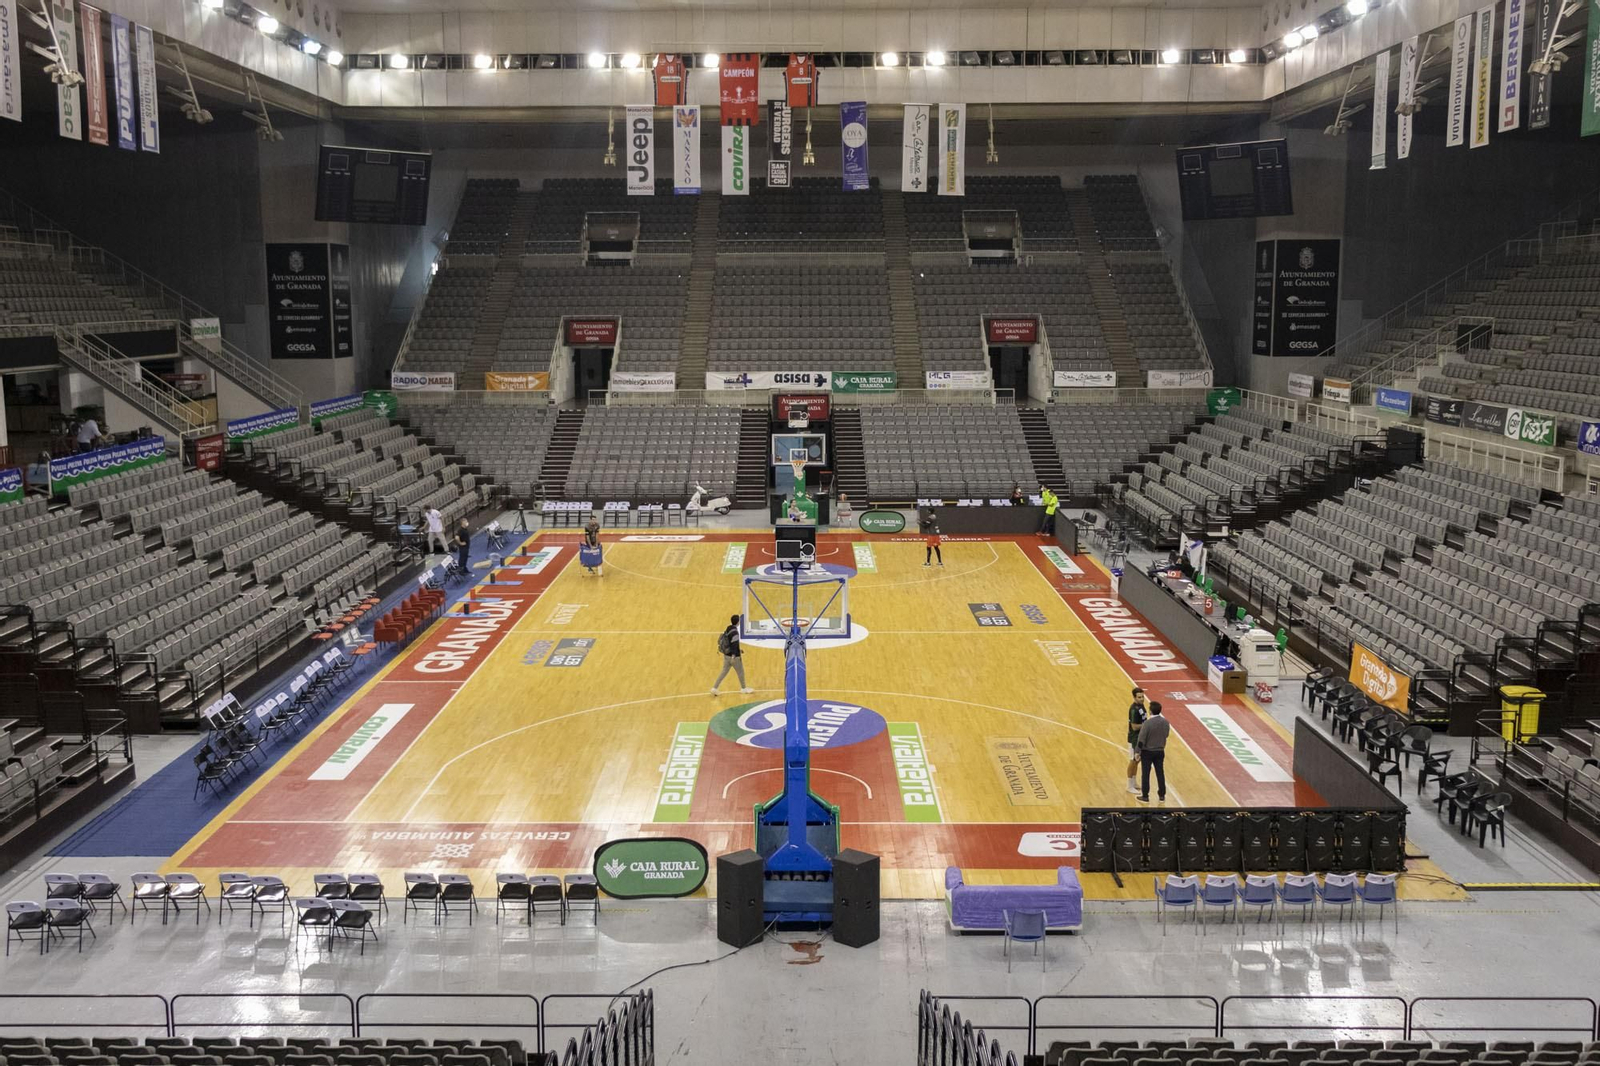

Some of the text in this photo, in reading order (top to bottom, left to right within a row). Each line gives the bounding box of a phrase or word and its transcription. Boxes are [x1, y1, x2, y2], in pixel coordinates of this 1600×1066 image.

[1506, 0, 1521, 100] BERNER
[666, 66, 674, 74] 18
[723, 67, 755, 79] CAMPEÓN
[799, 67, 804, 75] 8
[1477, 61, 1487, 142] ALHAMBRA
[773, 111, 781, 143] VERDAD
[628, 117, 653, 182] Jeep
[683, 130, 691, 184] MANZANO
[271, 273, 326, 281] AYUNTAMIENTO
[1279, 270, 1336, 278] AYUNTAMIENTO
[1295, 278, 1330, 287] GRANADA
[287, 281, 322, 290] GRANADA
[393, 377, 453, 385] RADIO MARCA
[774, 373, 810, 384] asisa
[1205, 598, 1212, 609] 5
[414, 599, 525, 673] GRANADA
[1078, 597, 1189, 673] GRANADA
[1359, 652, 1388, 685] Granada
[1362, 671, 1388, 697] Digital
[807, 703, 863, 748] PULEVA
[660, 735, 705, 805] Vialterra
[892, 735, 935, 805] Vialterra
[998, 755, 1025, 796] DE GRANADA
[1016, 751, 1049, 800] AYUNTAMIENTO
[372, 831, 474, 841] ALHAMBRA
[480, 831, 571, 841] CERVEZAS
[630, 860, 700, 872] CAJA RURAL
[644, 871, 684, 879] GRANADA
